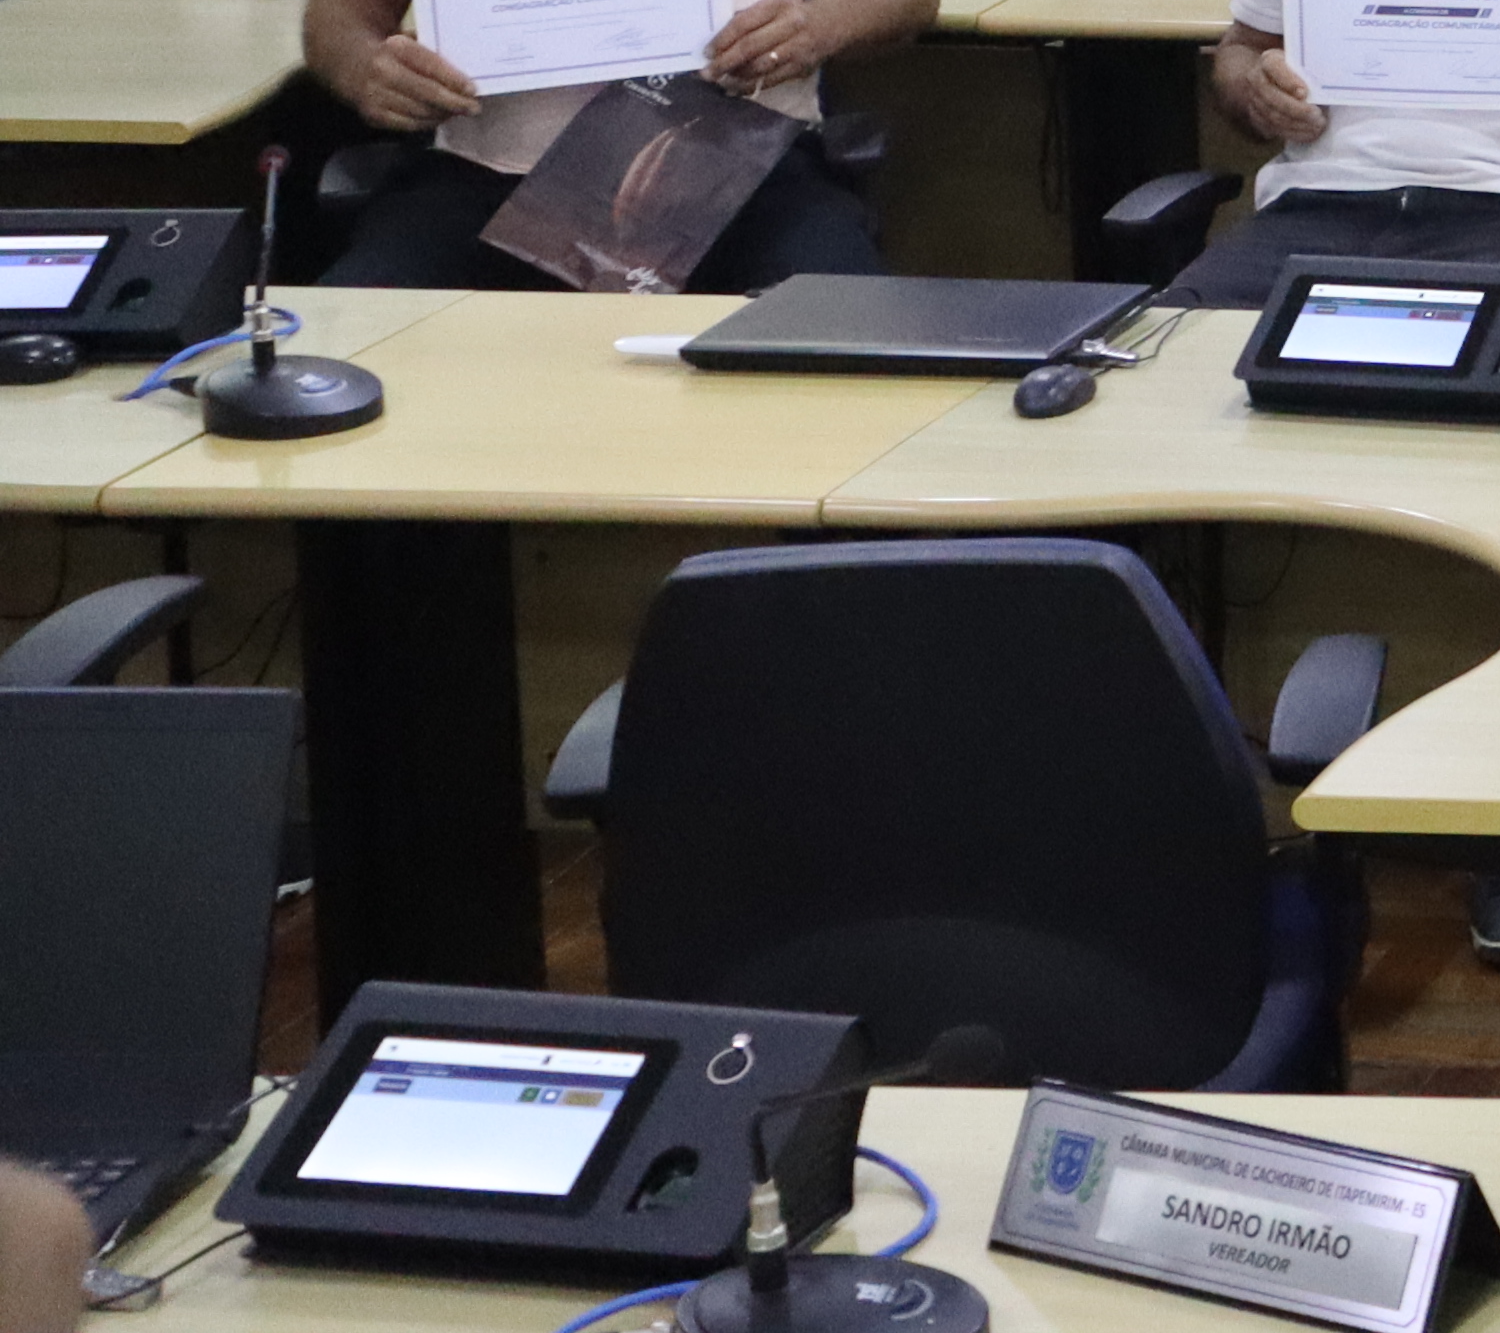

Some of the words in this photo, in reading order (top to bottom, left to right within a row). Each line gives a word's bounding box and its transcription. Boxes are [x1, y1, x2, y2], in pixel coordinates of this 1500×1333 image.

[1120, 1134, 1170, 1160] CÂMARA
[1173, 1146, 1233, 1177] MUNICIPAL
[1234, 1160, 1250, 1178] DE
[1252, 1165, 1316, 1194] CACHOEIRO
[1317, 1179, 1333, 1197] DE
[1335, 1181, 1404, 1214] ITAPEMIRIM
[1412, 1200, 1426, 1218] ES
[1162, 1194, 1261, 1239] SANDRO
[1267, 1217, 1351, 1259] IRMÃO
[1208, 1242, 1292, 1274] VEREADOR
